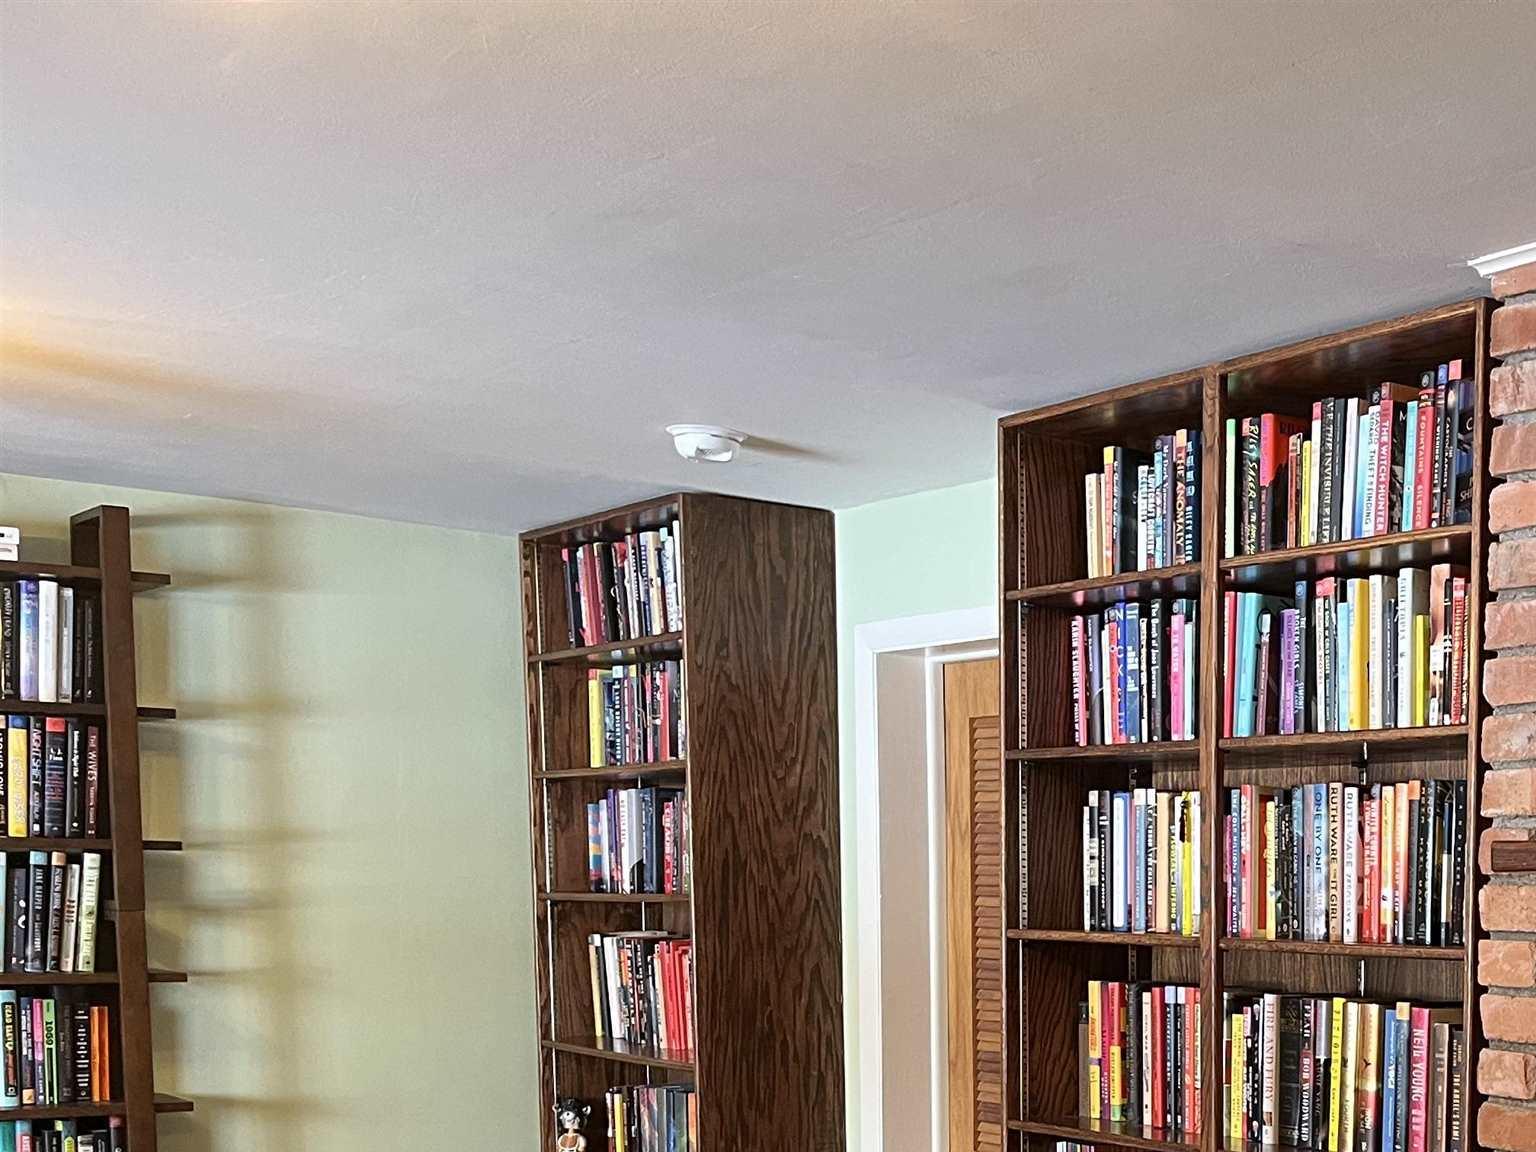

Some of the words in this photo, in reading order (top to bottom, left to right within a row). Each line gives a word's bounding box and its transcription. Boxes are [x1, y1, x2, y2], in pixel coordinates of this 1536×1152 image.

[1380, 420, 1389, 442] THE
[1378, 445, 1388, 481] WITCH
[1175, 480, 1186, 547] ANOMALY
[1375, 483, 1386, 531] HUNTER
[88, 751, 97, 781] WIVES
[1315, 792, 1323, 820] ONE
[1330, 787, 1338, 823] RUTH
[1315, 826, 1323, 842] BY
[1330, 827, 1338, 864] WARE
[1330, 880, 1338, 890] IT
[1330, 894, 1338, 921] GIRL
[1266, 1002, 1275, 1032] FIRE
[1302, 1004, 1311, 1038] FEAR
[1265, 1038, 1274, 1065] AND
[1411, 1028, 1425, 1057] NEIL
[1302, 1057, 1310, 1080] BOB
[1411, 1062, 1425, 1102] YOUNG
[1264, 1068, 1274, 1102] FURY
[1300, 1082, 1310, 1142] WOODWARD
